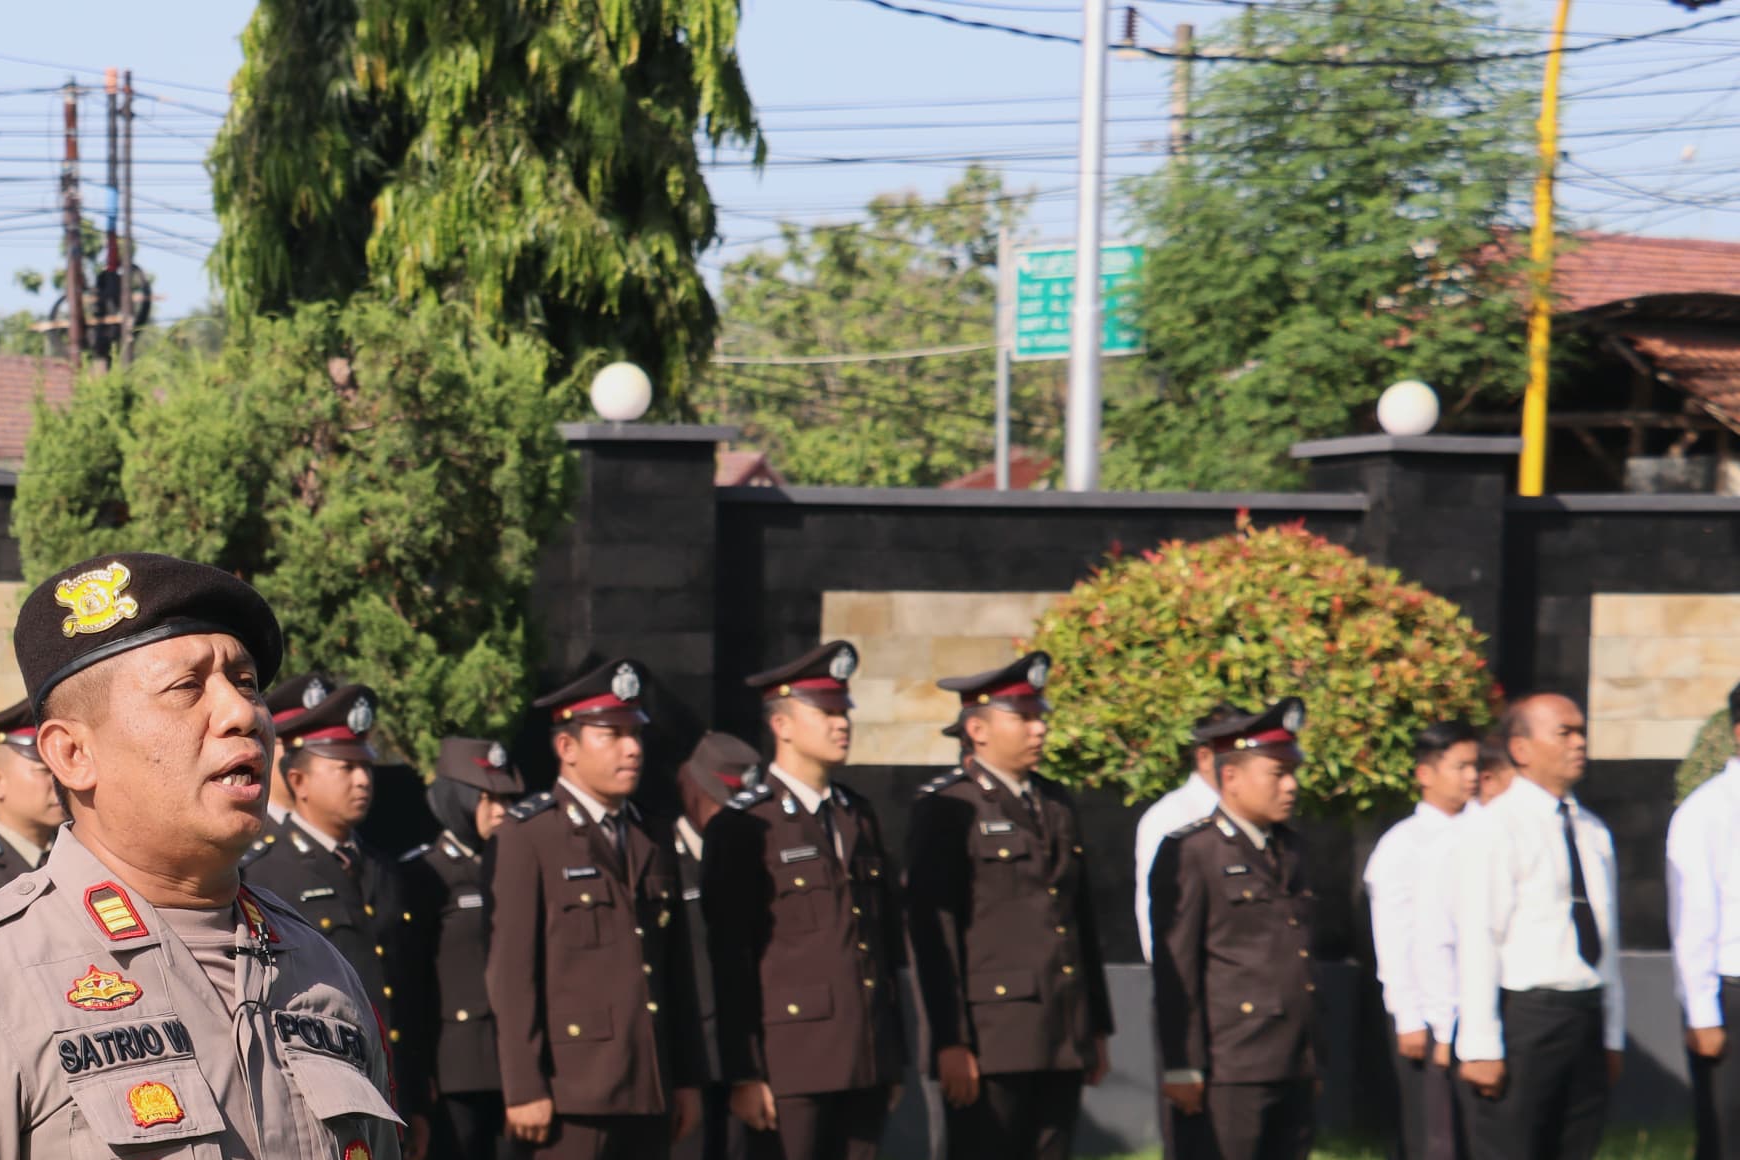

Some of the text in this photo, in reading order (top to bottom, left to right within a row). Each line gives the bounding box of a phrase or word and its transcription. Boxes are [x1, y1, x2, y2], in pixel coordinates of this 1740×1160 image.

[59, 1020, 195, 1074] SATRIO W
[275, 1012, 367, 1063] POLRI
